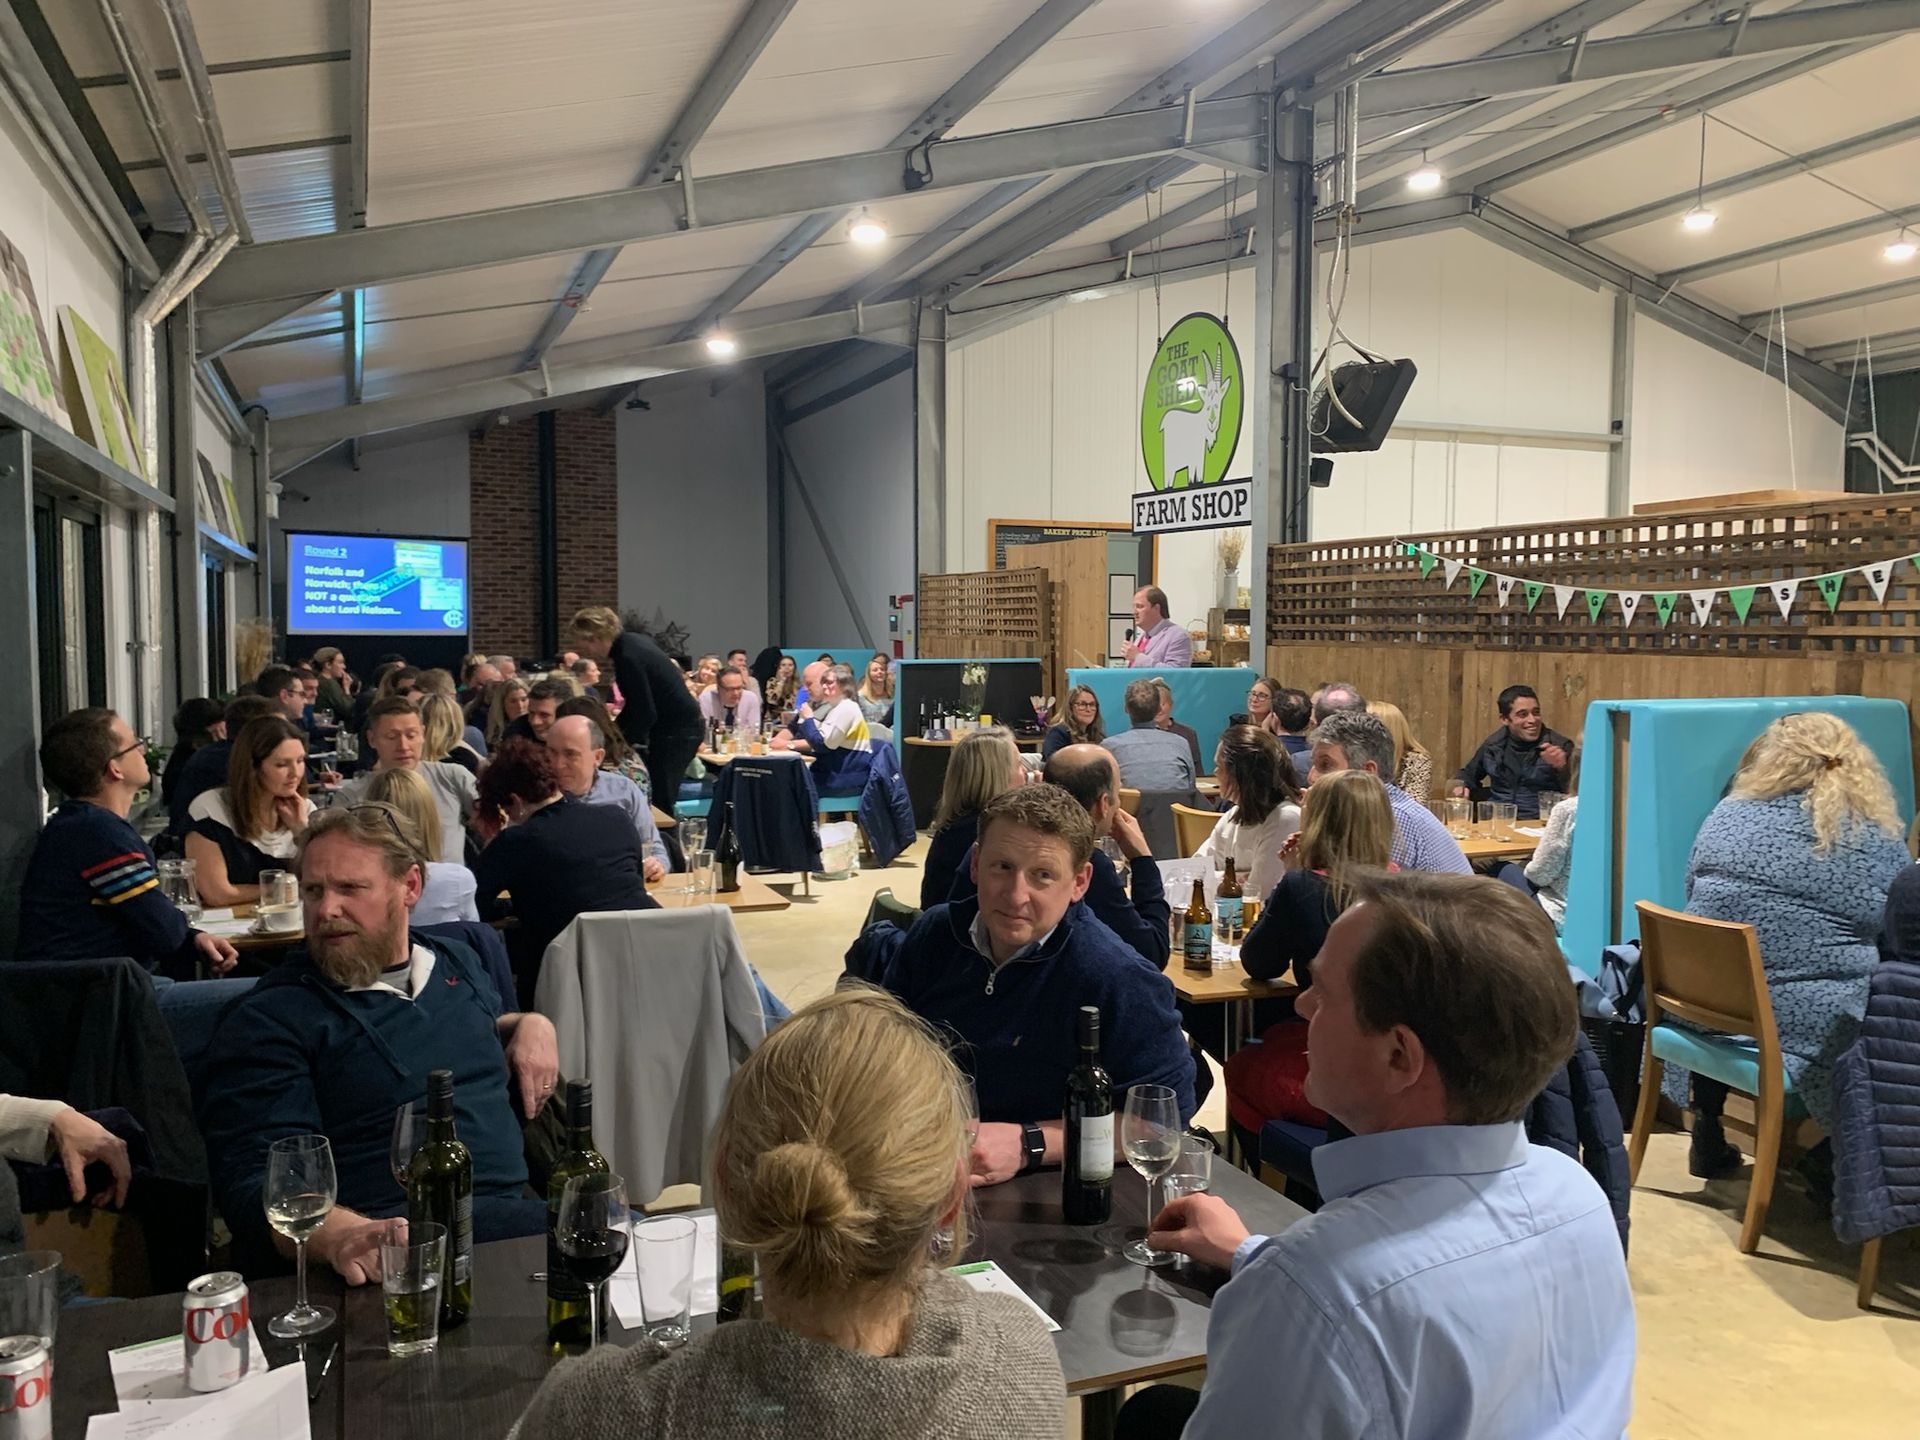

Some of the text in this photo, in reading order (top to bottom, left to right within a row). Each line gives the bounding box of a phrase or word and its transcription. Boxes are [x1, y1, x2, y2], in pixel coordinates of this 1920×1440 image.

[1166, 341, 1190, 362] THE
[1157, 356, 1199, 385] GOAT
[1156, 380, 1197, 408] SHED
[1136, 488, 1248, 527] FARM SHOP
[304, 545, 347, 558] Round 2
[305, 566, 364, 578] Norfolk and
[305, 592, 327, 601] NOT
[331, 594, 337, 602] a
[1591, 595, 1706, 611] GOAT
[305, 605, 337, 614] about
[338, 606, 359, 614] Lord
